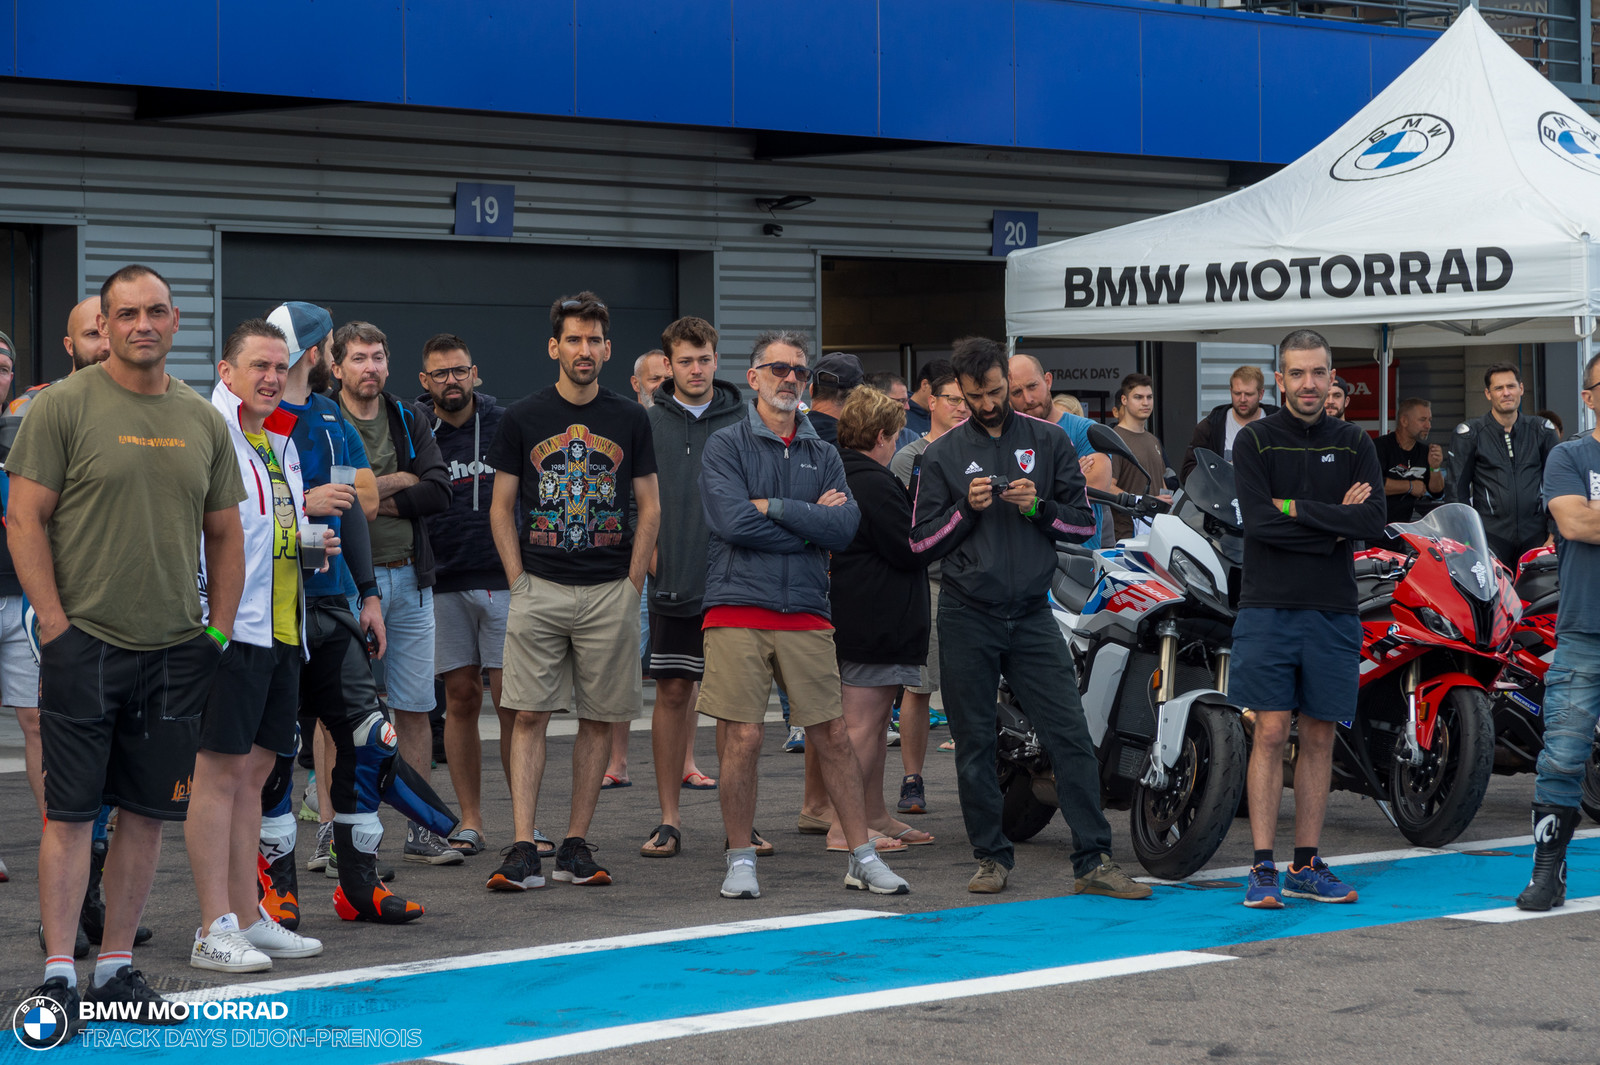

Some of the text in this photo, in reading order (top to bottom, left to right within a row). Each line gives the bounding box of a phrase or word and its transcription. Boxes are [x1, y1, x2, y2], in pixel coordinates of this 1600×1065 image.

[1368, 117, 1447, 144] BMW
[1543, 116, 1598, 142] BMW
[471, 196, 499, 224] 19
[1004, 221, 1027, 246] 20
[1064, 246, 1514, 308] BMW MOTORRAD
[1050, 367, 1120, 380] TRACK DAYS
[550, 463, 607, 473] 1988 TOUR
